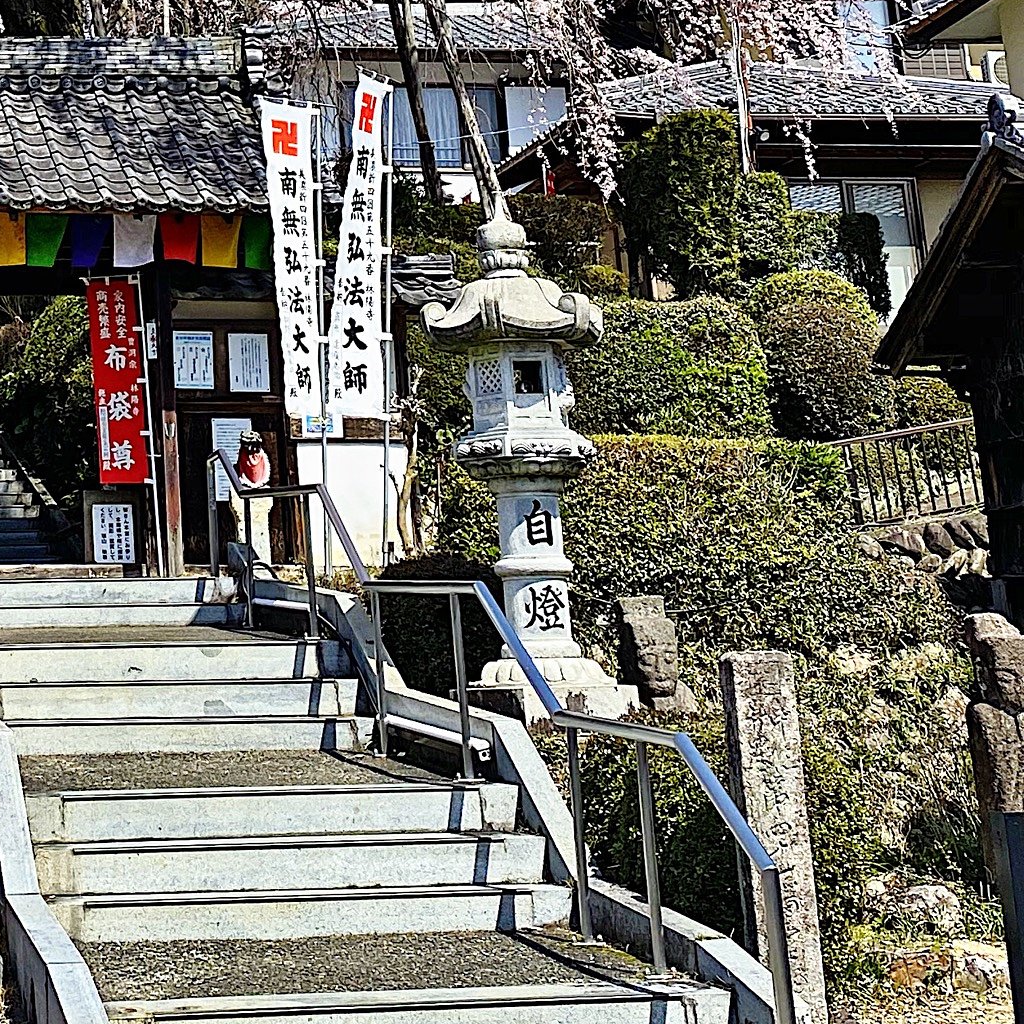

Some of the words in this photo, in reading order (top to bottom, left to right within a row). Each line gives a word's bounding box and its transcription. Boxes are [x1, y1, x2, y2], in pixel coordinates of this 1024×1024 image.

[96, 290, 112, 339] 商売繁盛
[113, 290, 128, 339] 家内安全
[278, 167, 312, 394] 南無弘法大師
[342, 145, 369, 395] 南無弘法大師
[104, 343, 136, 471] 布袋尊
[523, 499, 565, 632] 自燈
